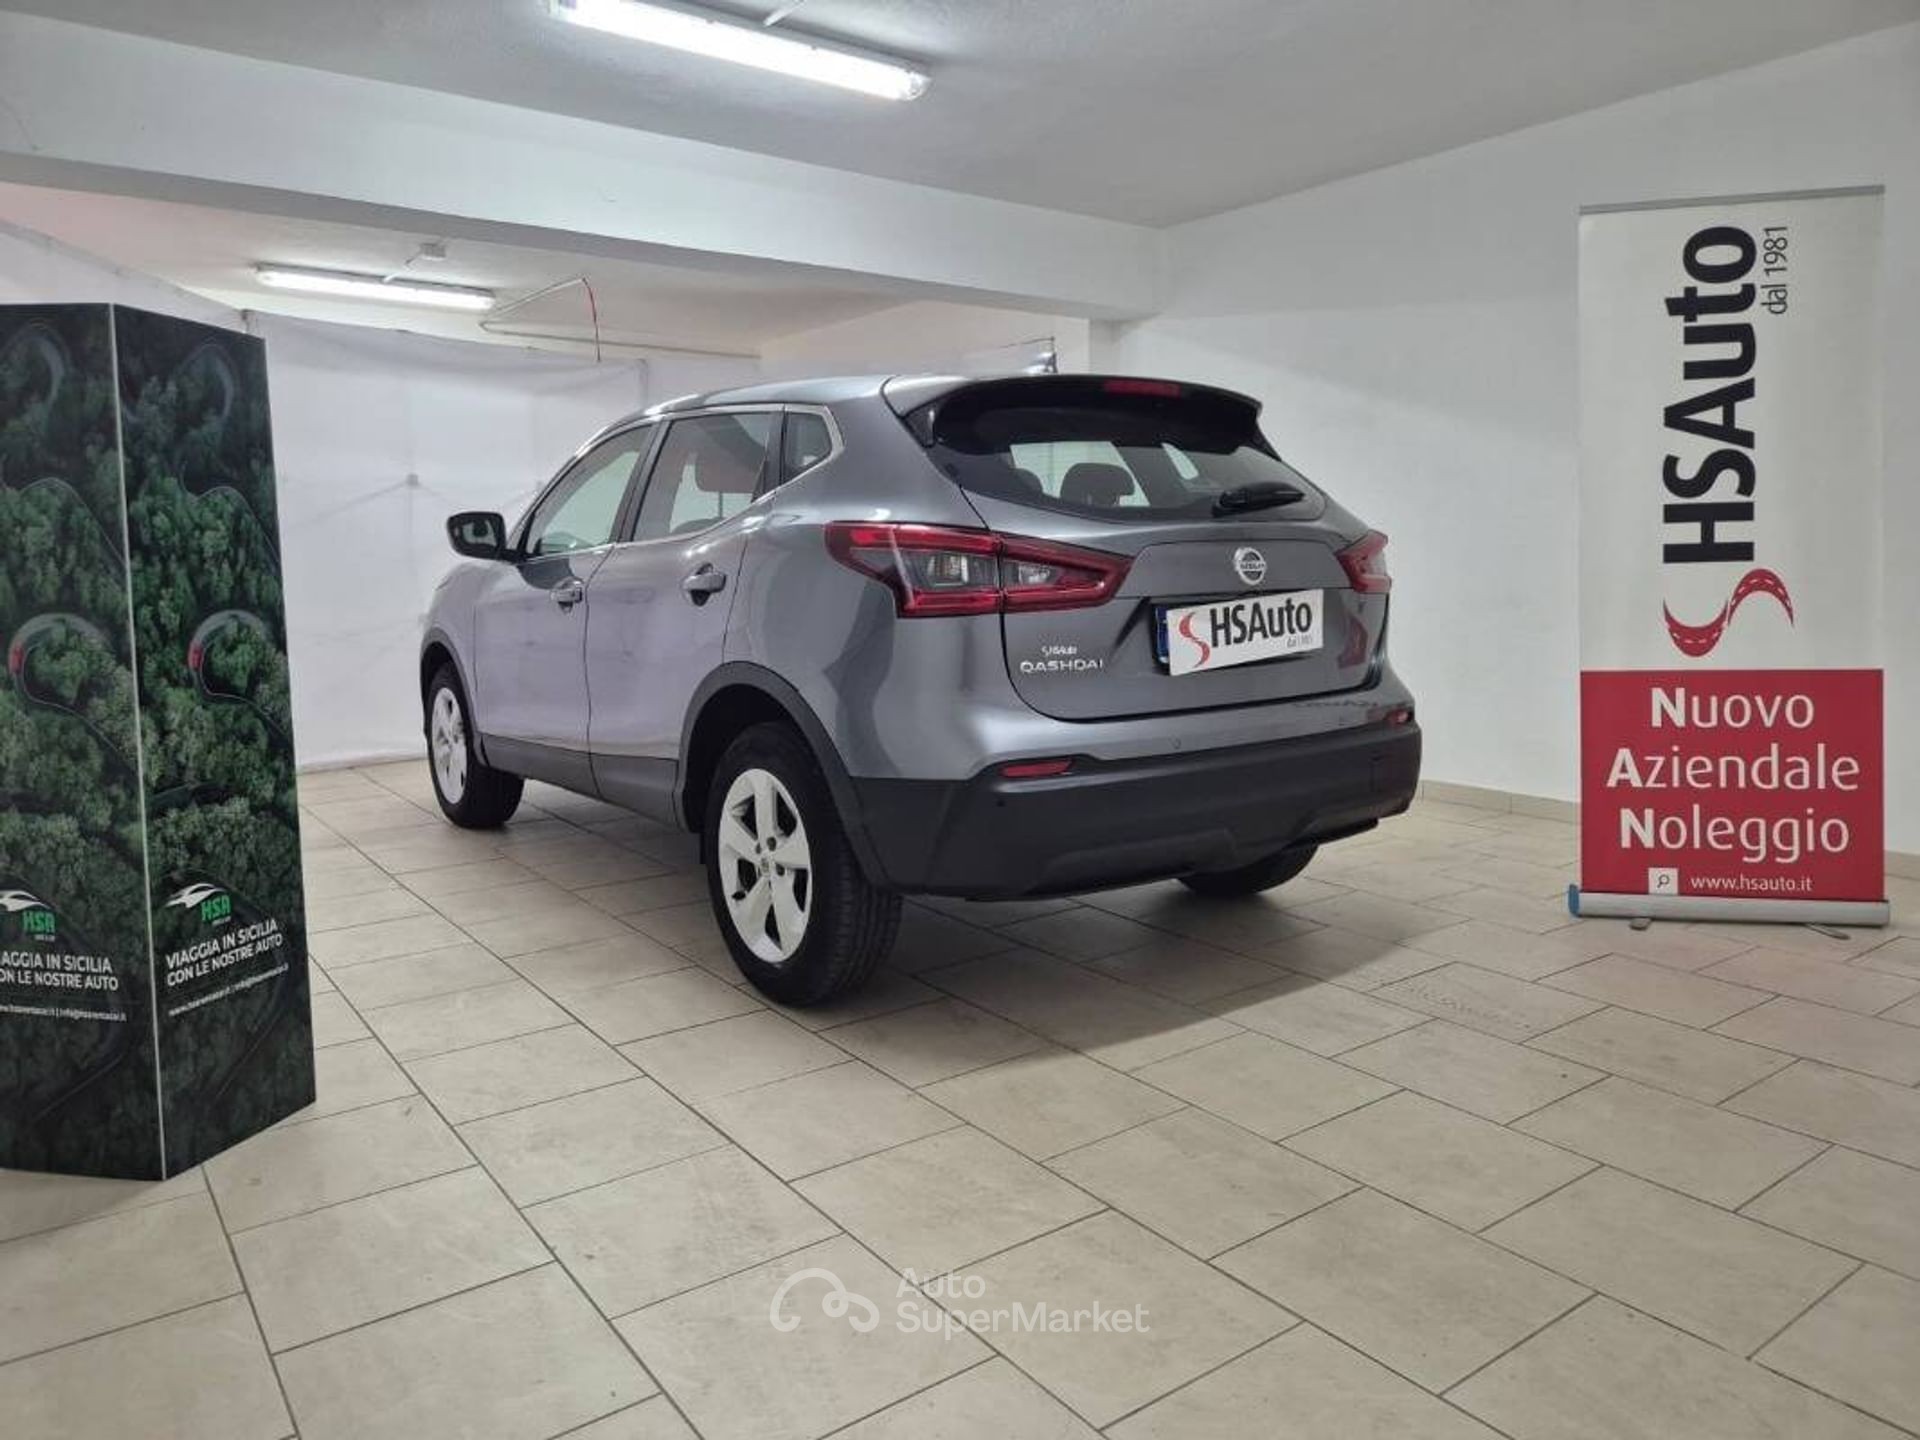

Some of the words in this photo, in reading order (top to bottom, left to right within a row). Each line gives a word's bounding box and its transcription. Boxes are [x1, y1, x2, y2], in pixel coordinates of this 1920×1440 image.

[1763, 226, 1788, 277] 1981
[1760, 284, 1788, 314] dal
[1662, 226, 1757, 564] HSAuto
[1210, 598, 1312, 647] HSAuto
[1651, 687, 1815, 728] Nuovo
[1606, 743, 1860, 790] Aziendale
[1620, 804, 1850, 863] Noleggio
[1691, 873, 1813, 892] www.hsauto.it
[0, 950, 43, 969] AGGIA
[47, 953, 61, 969] IN
[64, 954, 113, 973] SICILIA
[165, 939, 221, 969] VIAGGIA
[222, 932, 236, 950] IN
[238, 918, 278, 945] SICILIA
[167, 966, 194, 987] CON
[196, 960, 210, 977] LE
[212, 944, 254, 970] NOSTRE
[255, 933, 283, 954] AUTO
[18, 970, 32, 984] LE
[35, 971, 82, 988] NOSTRE
[85, 975, 119, 991] AUTO
